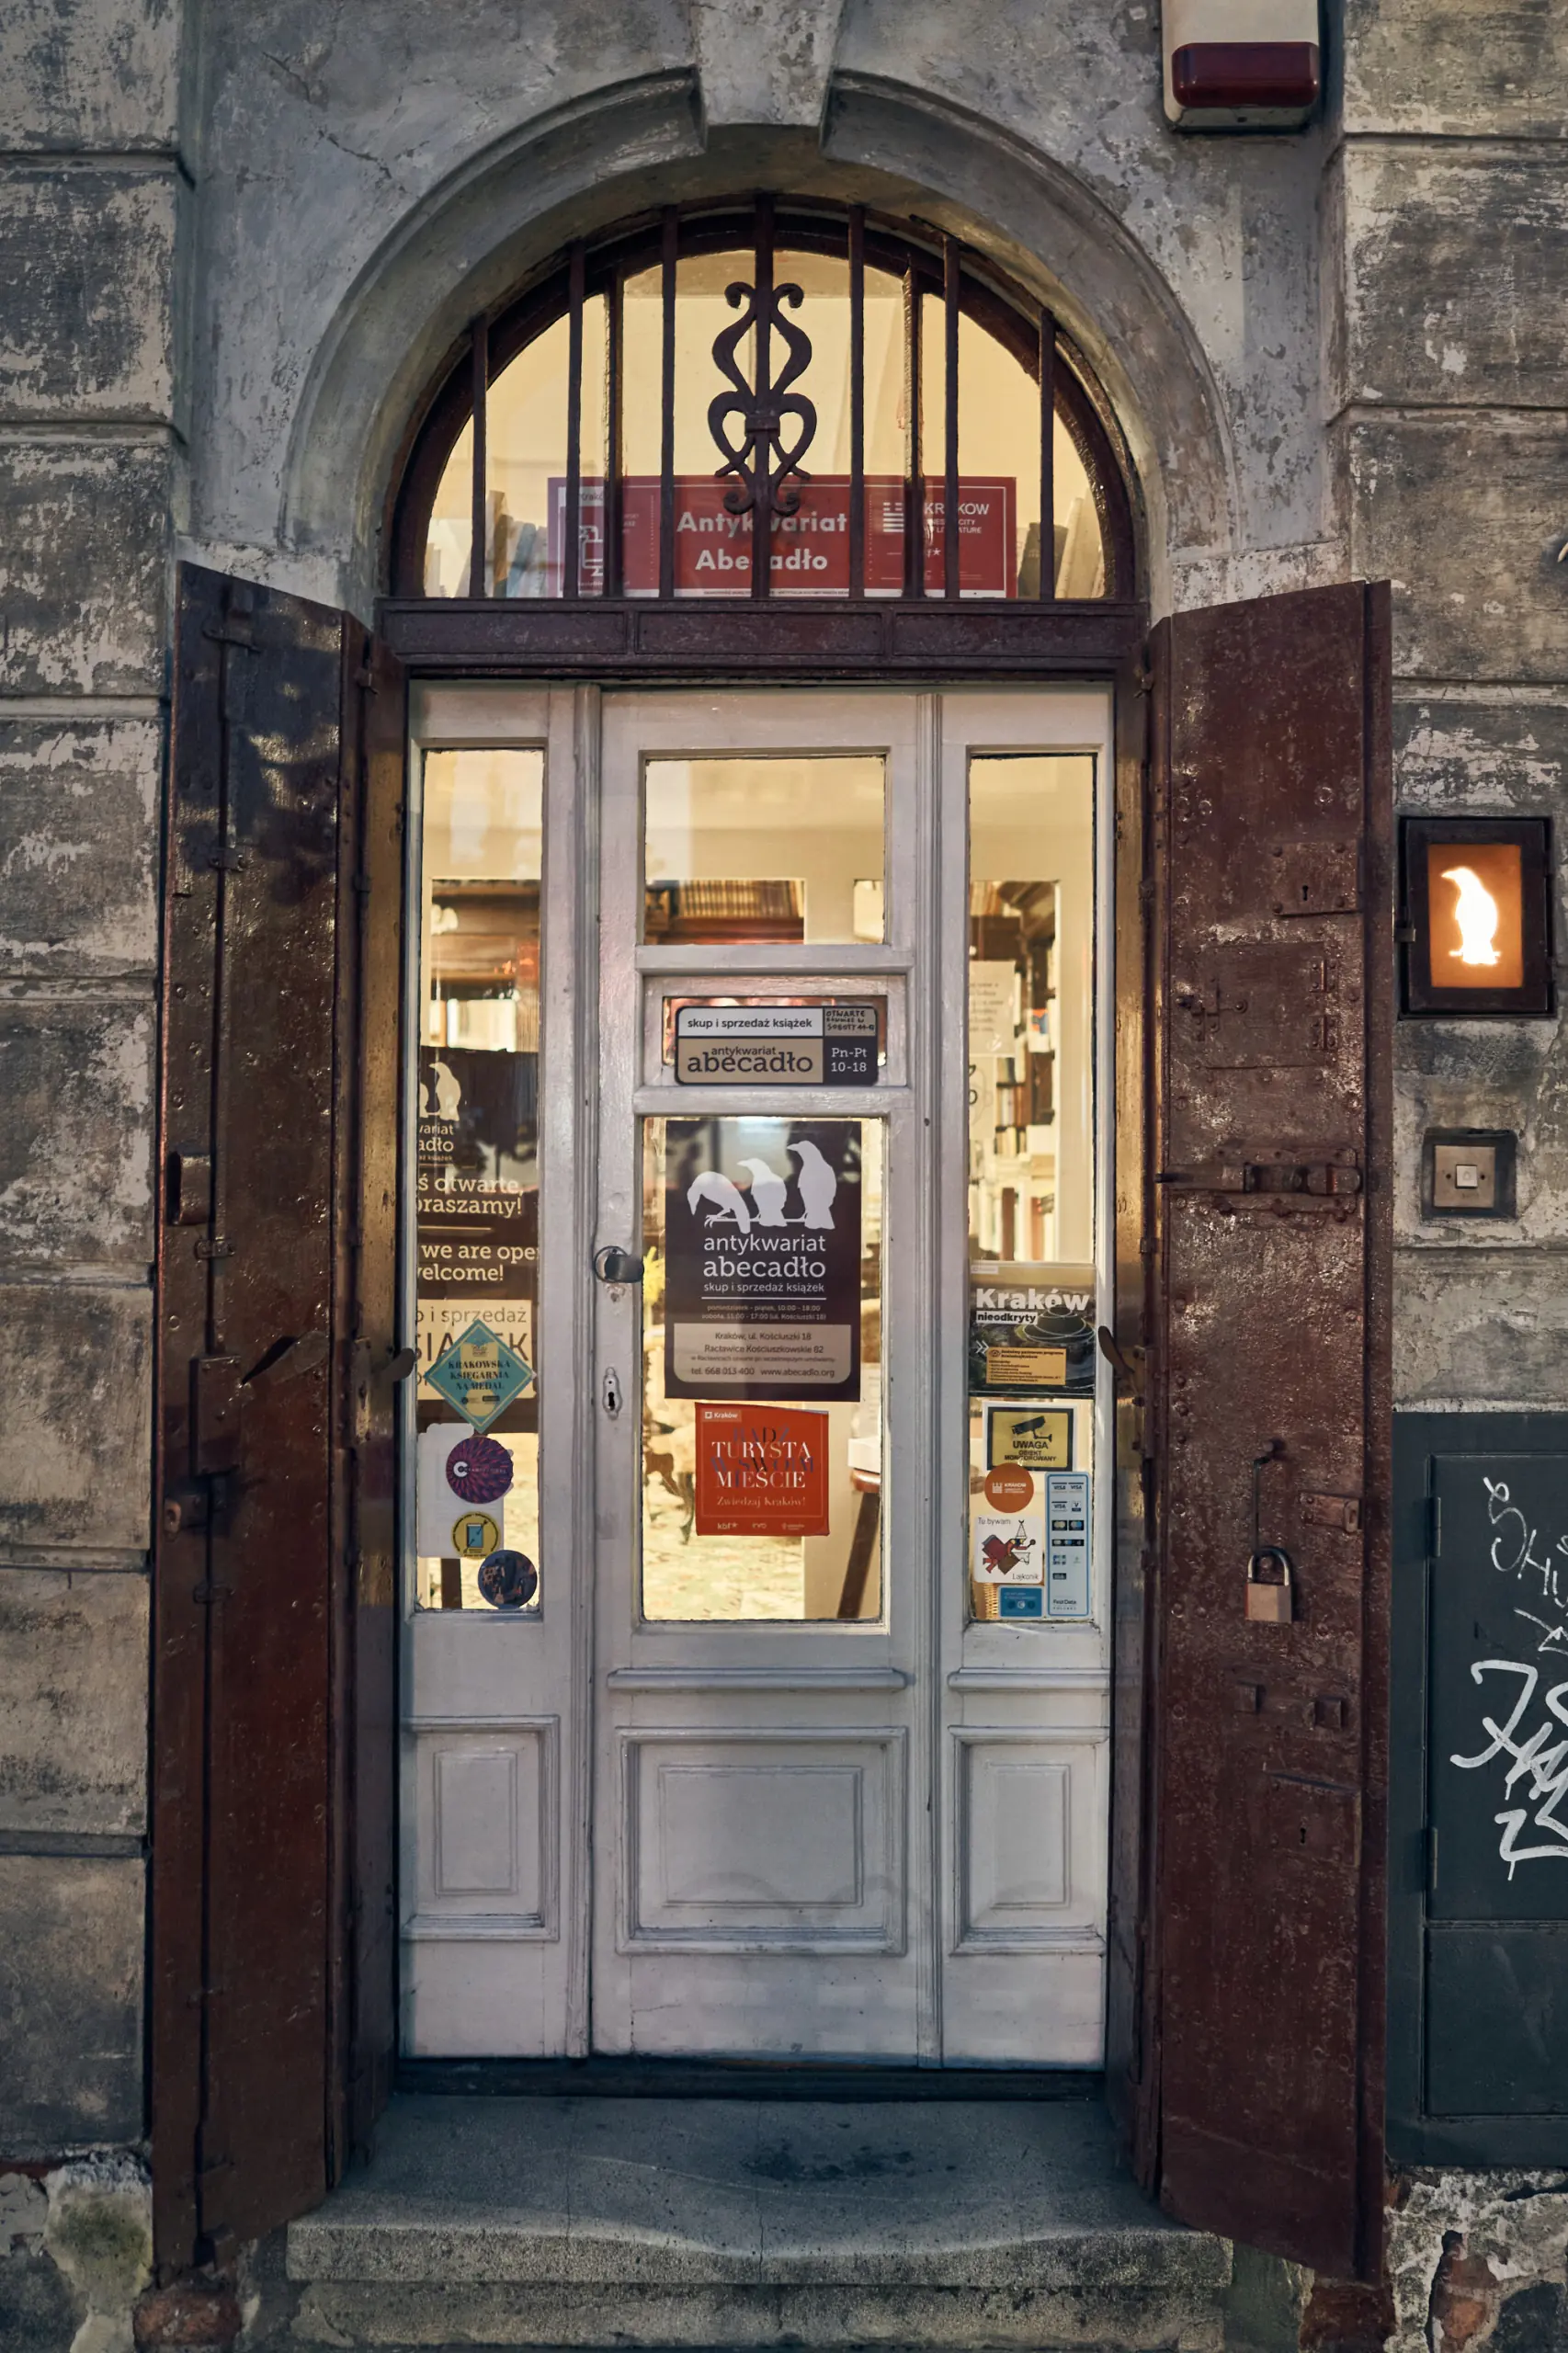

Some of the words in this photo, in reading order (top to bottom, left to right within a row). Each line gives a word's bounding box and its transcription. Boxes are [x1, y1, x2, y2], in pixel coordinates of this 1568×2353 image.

[695, 548, 828, 571] Abeadło
[687, 1018, 713, 1030] skup
[716, 1018, 720, 1028] i
[722, 1017, 769, 1030] sprzedaż
[773, 1018, 812, 1030] książek
[711, 1046, 777, 1058] antykwariat
[832, 1047, 868, 1058] Pn-Pt
[687, 1051, 813, 1073] abecadło
[831, 1062, 867, 1073] 10-18
[434, 1176, 523, 1197] otwarte,
[703, 1233, 826, 1256] antykwariat
[421, 1245, 453, 1258] we
[458, 1245, 492, 1259] are
[703, 1256, 826, 1278] abecadło
[704, 1282, 728, 1293] skup
[731, 1282, 734, 1291] i
[737, 1282, 784, 1294] sprzedaż
[787, 1282, 824, 1294] książek
[976, 1287, 1090, 1311] Kraków
[441, 1306, 527, 1326] sprzedaż
[977, 1313, 1037, 1325] nieodkryty
[715, 1332, 745, 1341] Kraków,
[759, 1332, 800, 1340] Kościuszki
[448, 1360, 511, 1370] KRAKOWSKA
[450, 1370, 510, 1381] KSIĘGARNIA
[471, 1381, 505, 1390] MEDAL
[1013, 1440, 1049, 1449] UWAGA
[711, 1441, 812, 1463] TURYSTĄ
[716, 1467, 806, 1488] MIEŚCIE
[717, 1496, 761, 1507] Zwiedzaj
[977, 1517, 985, 1525] Tu
[987, 1517, 1011, 1526] bywam
[1012, 1573, 1039, 1581] Lajkonik
